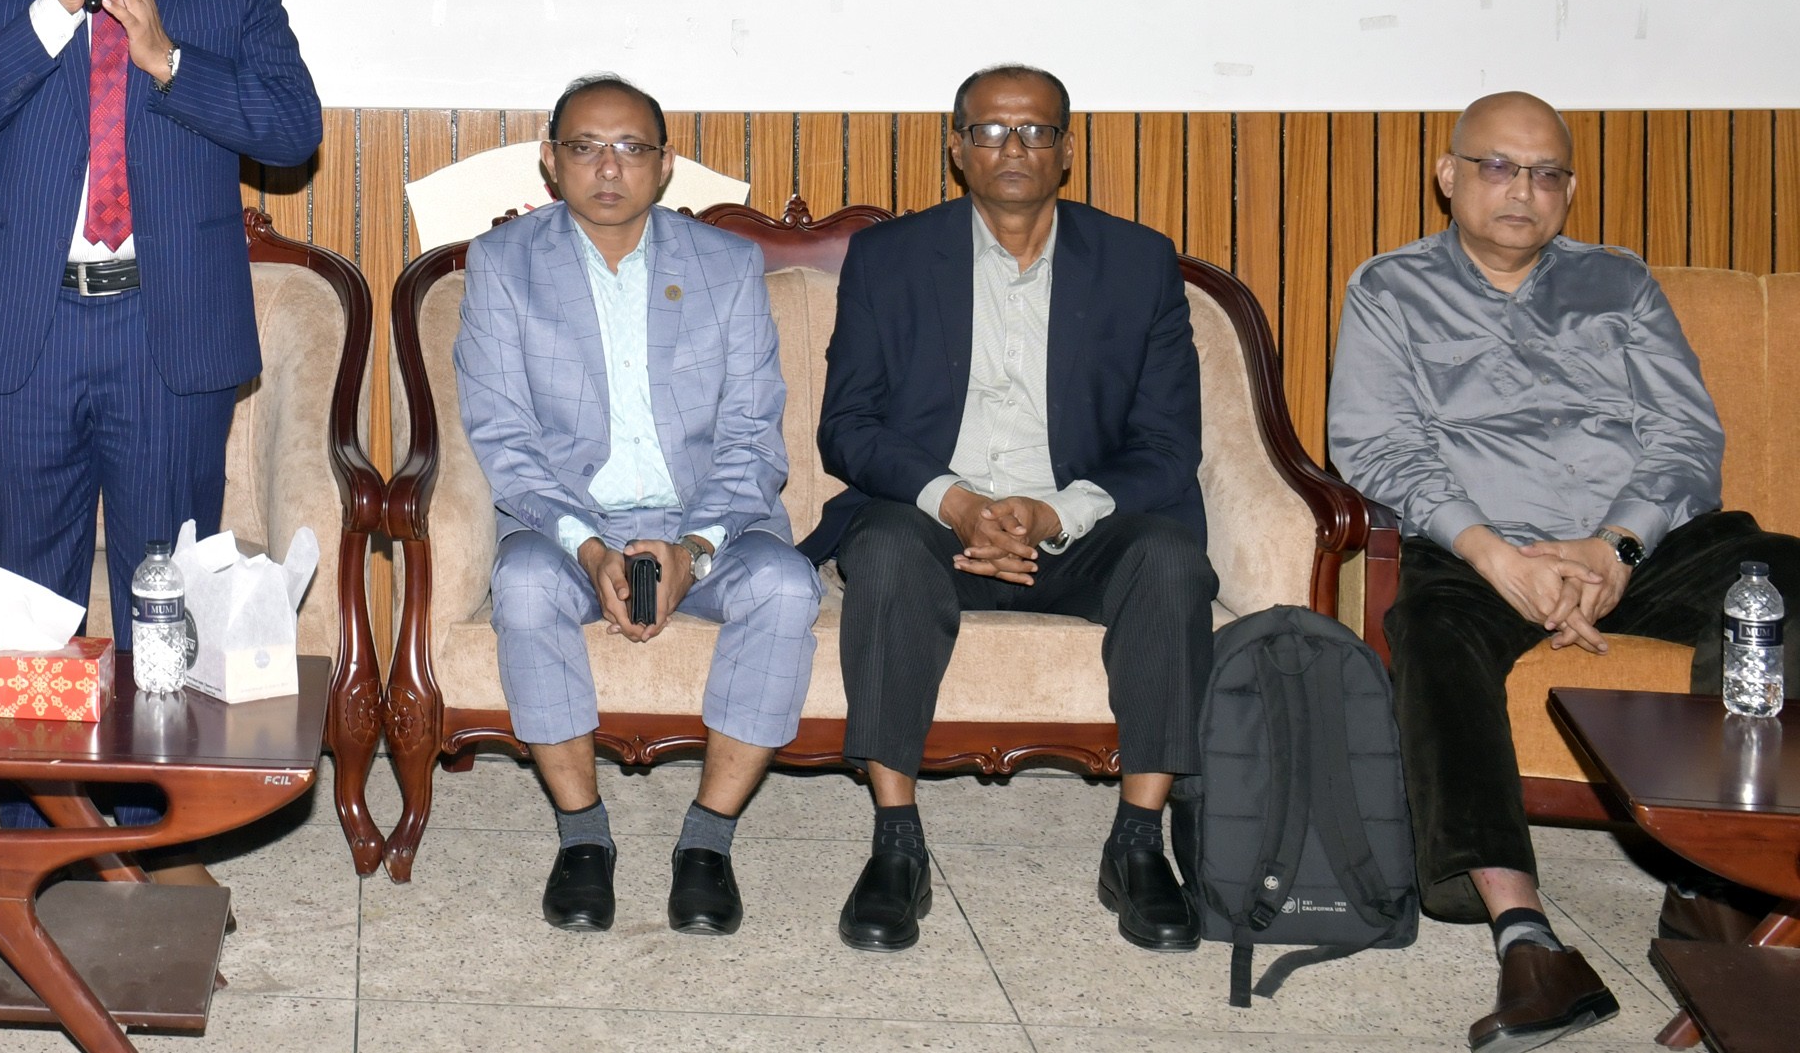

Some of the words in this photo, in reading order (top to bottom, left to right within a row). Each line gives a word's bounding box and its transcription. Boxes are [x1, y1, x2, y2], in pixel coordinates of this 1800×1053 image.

[151, 604, 174, 615] MUM
[1745, 627, 1771, 637] MUM
[264, 775, 292, 786] FCIL
